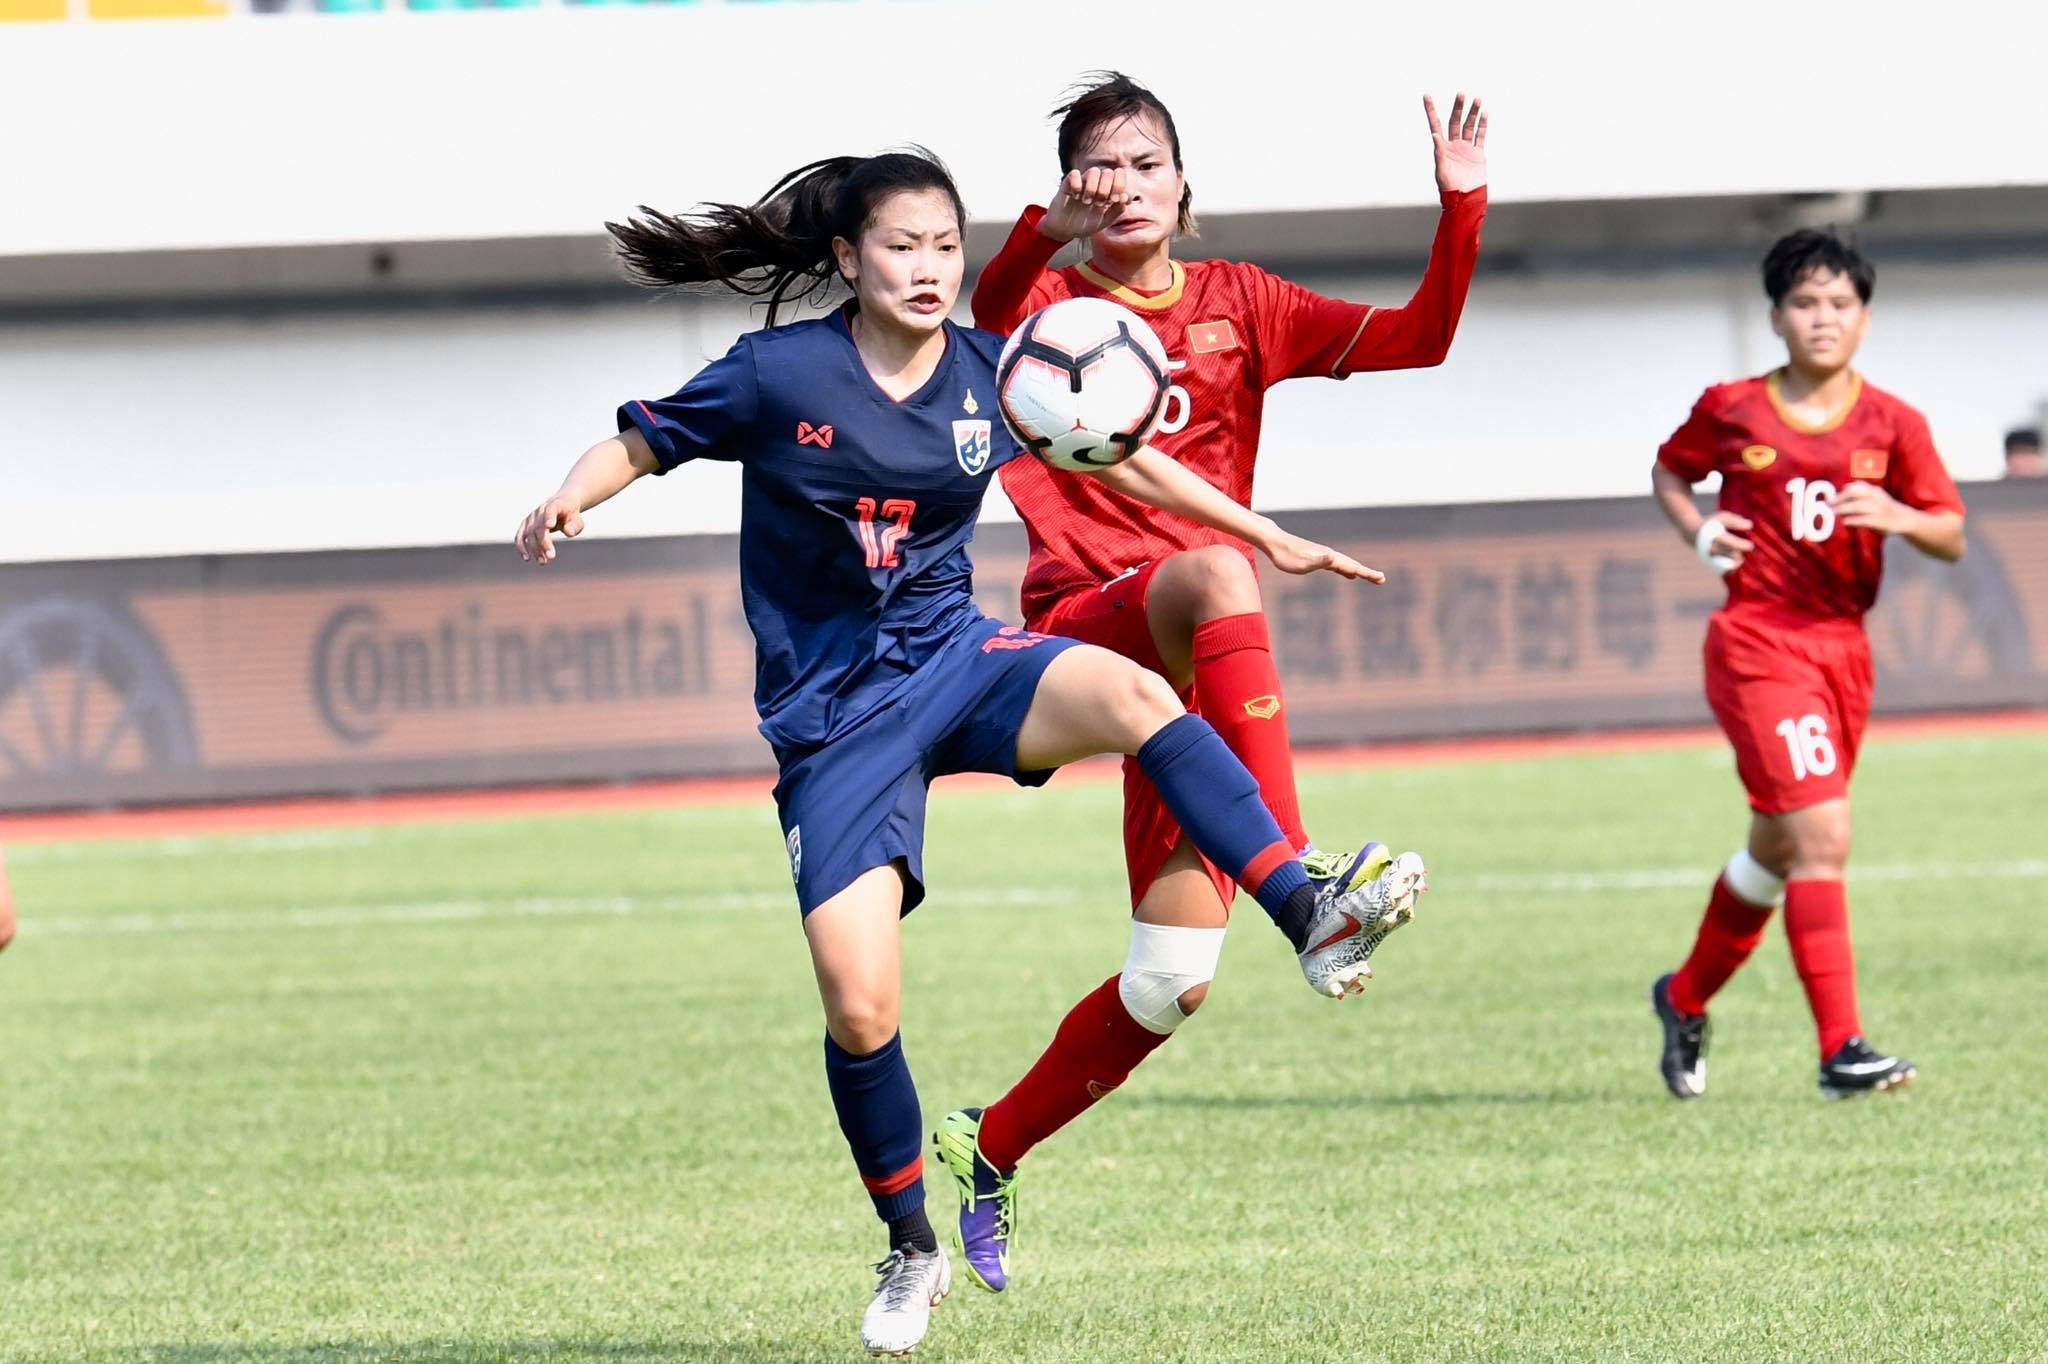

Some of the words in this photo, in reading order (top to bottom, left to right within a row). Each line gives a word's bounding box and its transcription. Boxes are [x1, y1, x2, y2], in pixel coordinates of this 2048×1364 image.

[854, 497, 916, 568] 12
[1785, 477, 1837, 542] 16
[309, 592, 712, 746] Continental
[1776, 714, 1837, 781] 16
